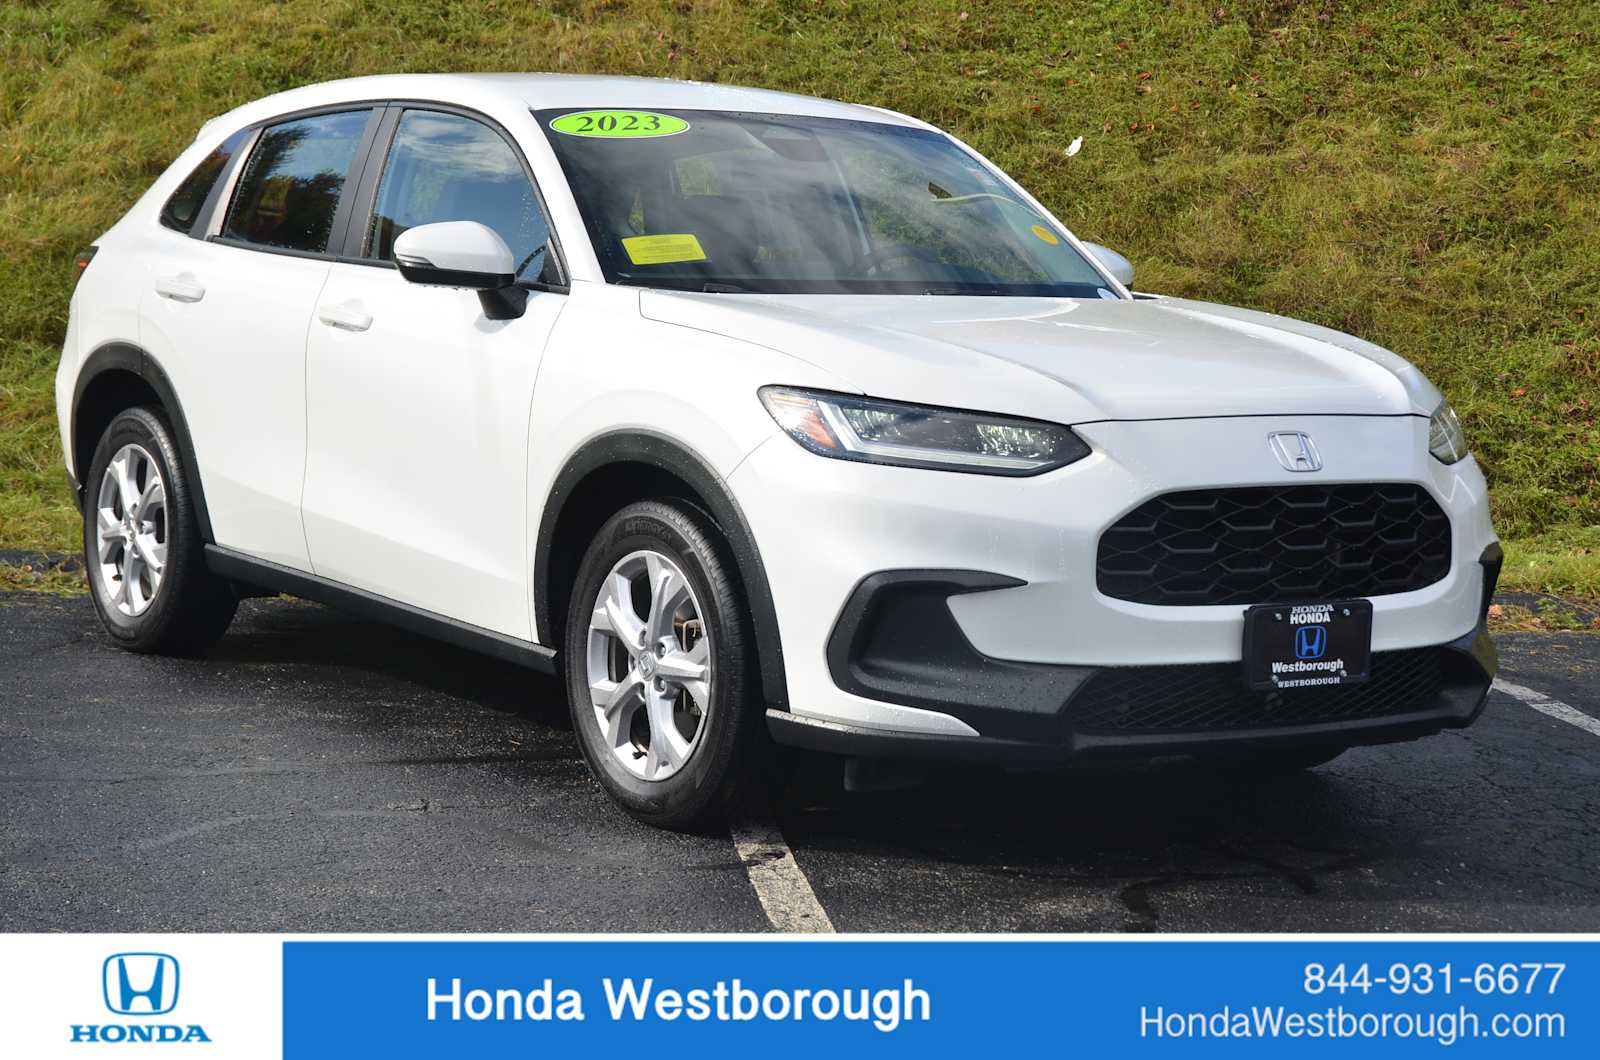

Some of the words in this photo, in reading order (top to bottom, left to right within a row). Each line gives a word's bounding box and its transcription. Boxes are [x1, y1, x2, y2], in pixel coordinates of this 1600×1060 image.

[576, 115, 661, 132] 2023
[1291, 604, 1334, 614] HONDA
[1289, 612, 1331, 625] HONDA
[1271, 658, 1344, 673] Westborough
[1277, 677, 1341, 688] WESTBOROUGH
